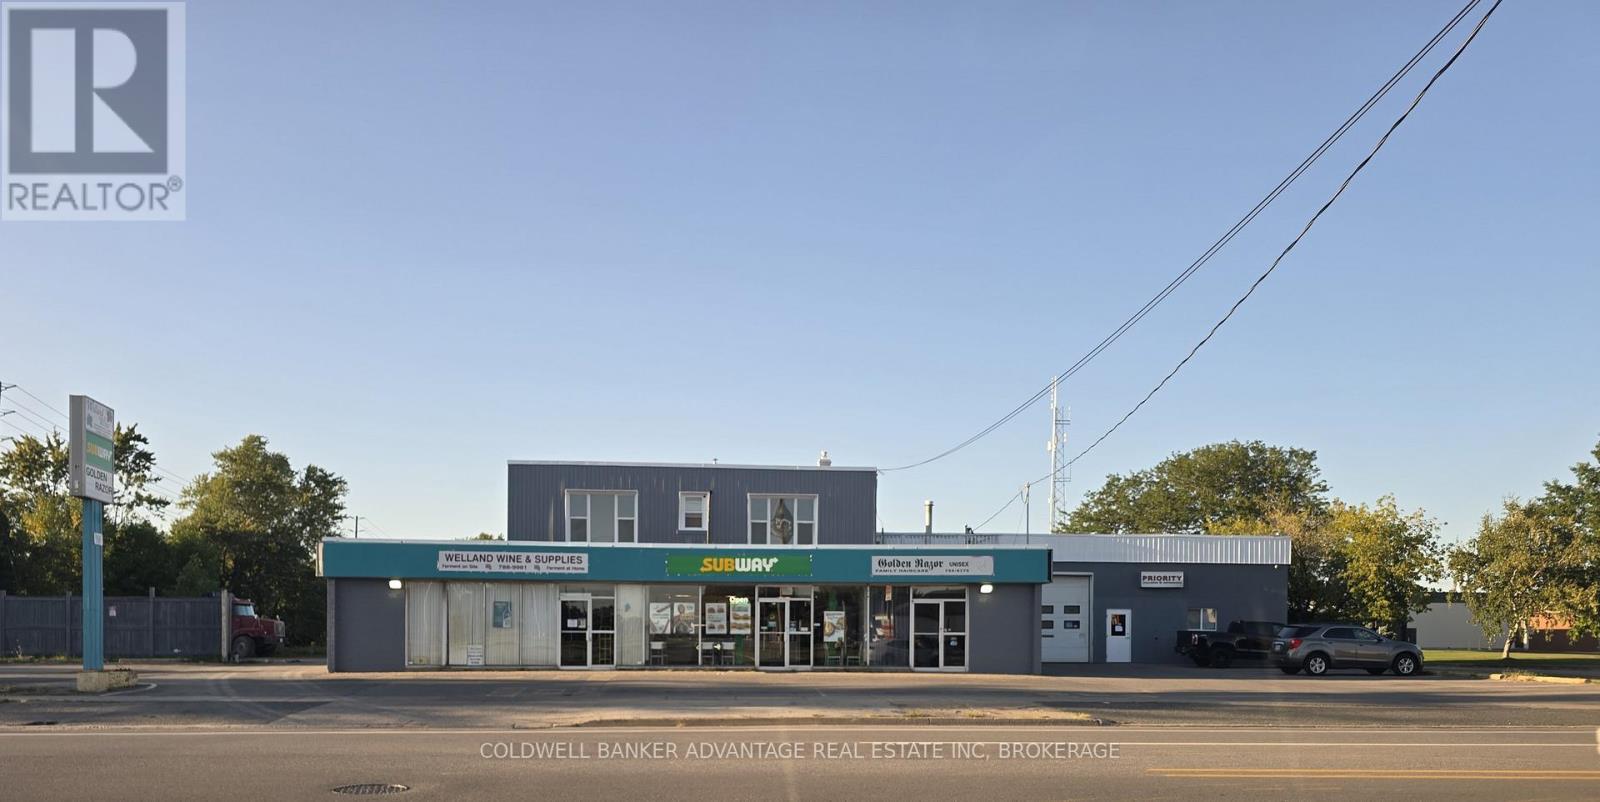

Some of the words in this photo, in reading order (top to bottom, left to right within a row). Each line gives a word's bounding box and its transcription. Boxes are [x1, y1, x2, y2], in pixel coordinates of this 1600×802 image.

[86, 466, 108, 482] GOLDEN
[95, 481, 113, 495] RAZOR
[444, 553, 494, 563] WELLAND
[496, 554, 522, 564] WINE
[525, 555, 532, 564] &
[535, 555, 583, 565] SUPPLIES
[700, 557, 779, 573] SUBWAY
[878, 558, 912, 568] Golden
[914, 558, 944, 570] Razor
